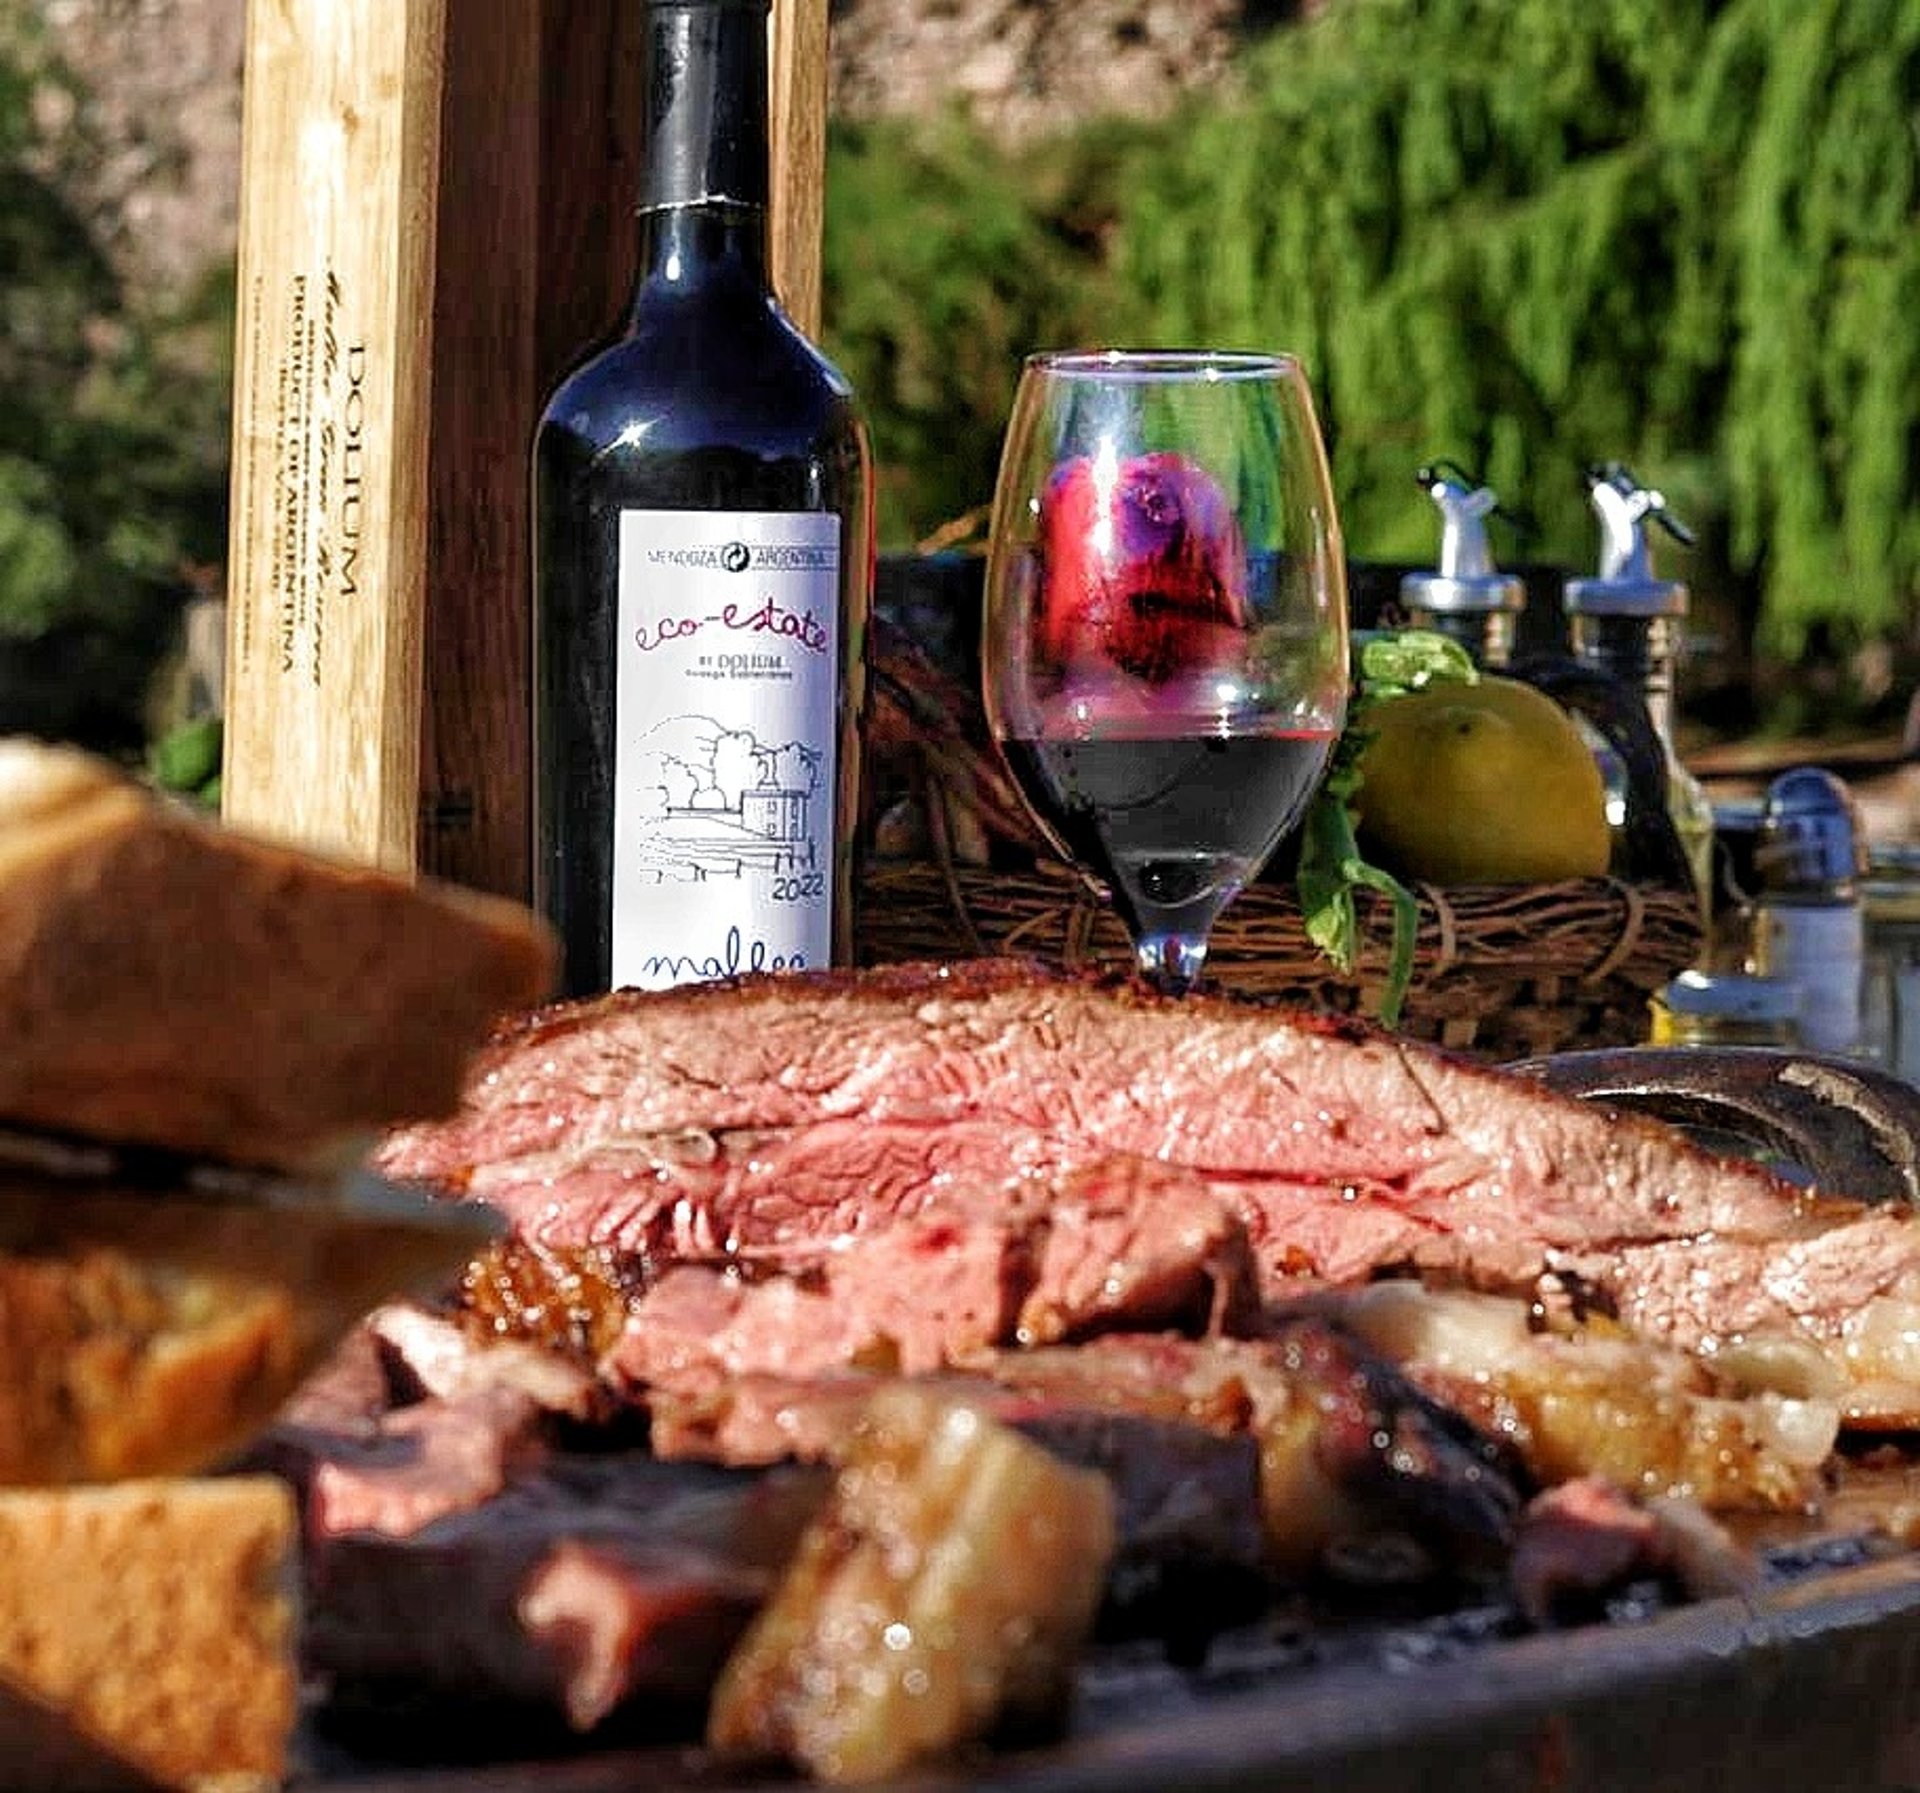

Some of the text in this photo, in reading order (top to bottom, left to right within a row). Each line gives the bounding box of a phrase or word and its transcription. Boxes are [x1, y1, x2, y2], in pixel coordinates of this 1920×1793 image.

[283, 274, 306, 673] PRODUCT OF ARGENTINA
[340, 346, 365, 595] DOLIUM
[647, 550, 718, 567] MENDOZA
[635, 596, 827, 652] eco-estate
[772, 873, 824, 902] 2022
